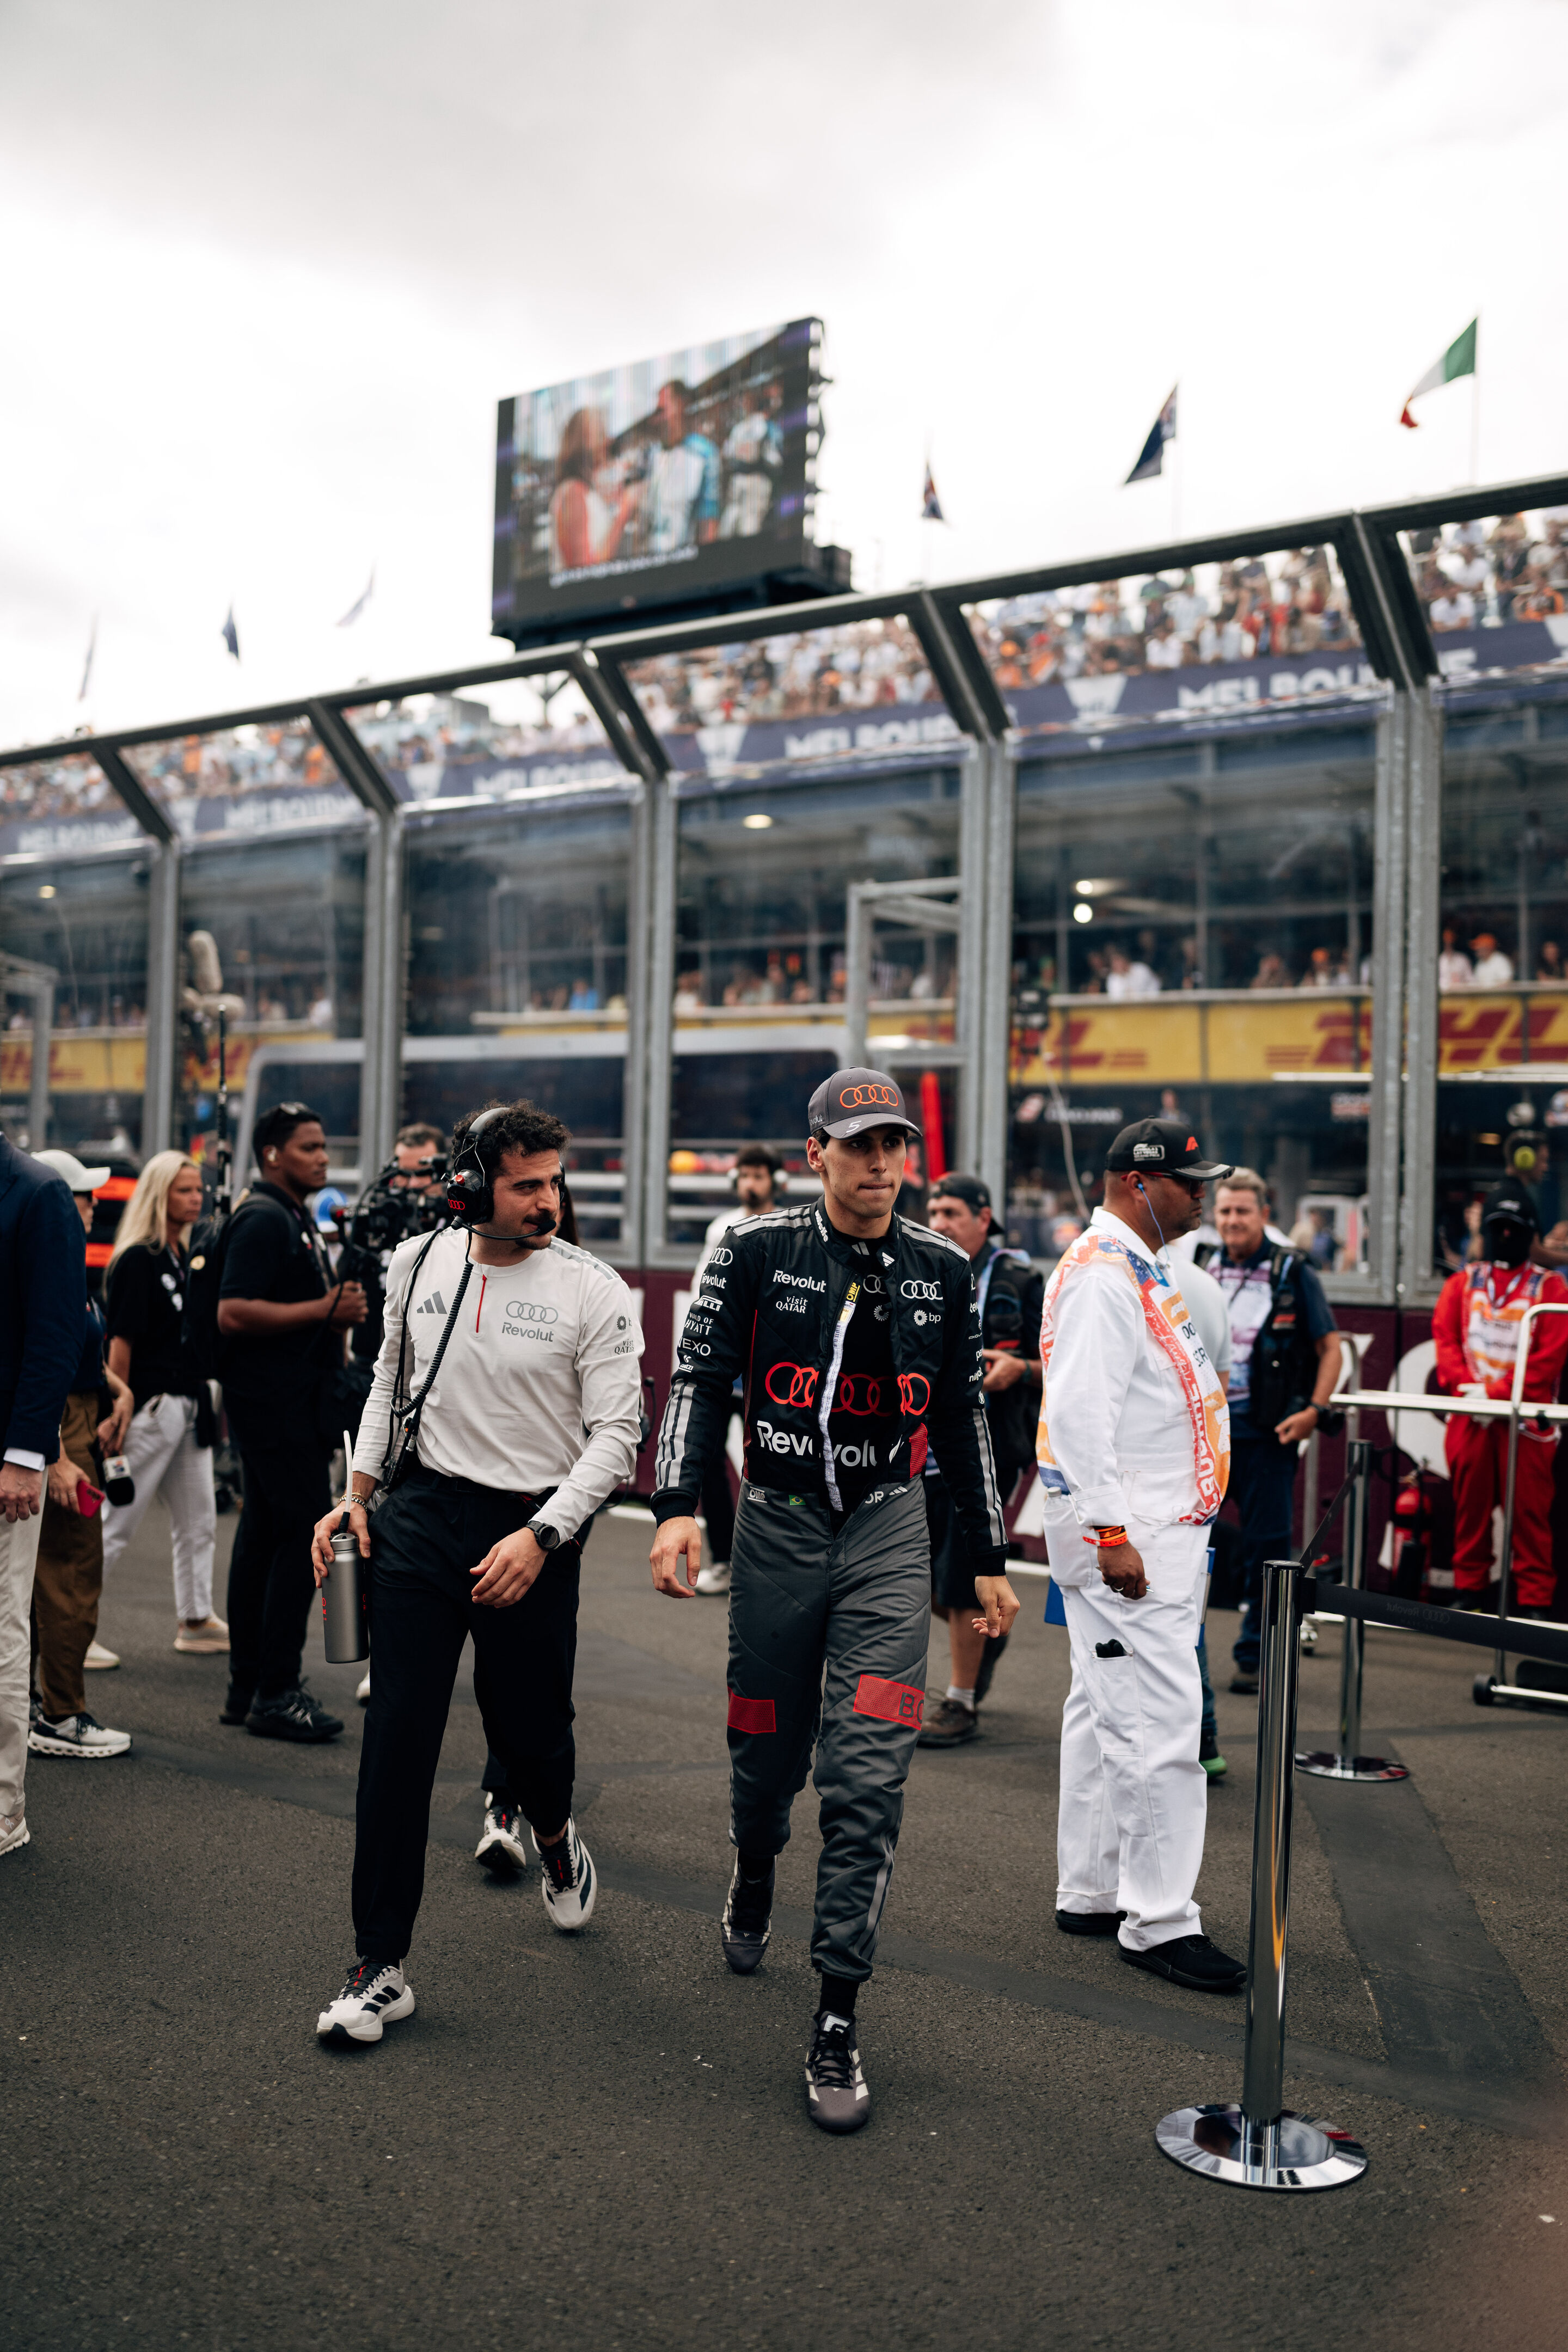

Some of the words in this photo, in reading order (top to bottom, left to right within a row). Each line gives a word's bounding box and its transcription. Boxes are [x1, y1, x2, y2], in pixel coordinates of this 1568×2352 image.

[809, 1114, 823, 1125] evolut
[846, 1120, 862, 1134] 5
[773, 1270, 826, 1293] Revolut
[846, 1282, 859, 1301] OMP
[775, 1301, 806, 1314] QATAR
[786, 1296, 808, 1307] visit
[929, 1313, 941, 1324] bp
[502, 1322, 554, 1342] Revolut
[684, 1319, 712, 1336] HYATT
[749, 1488, 765, 1501] OMP
